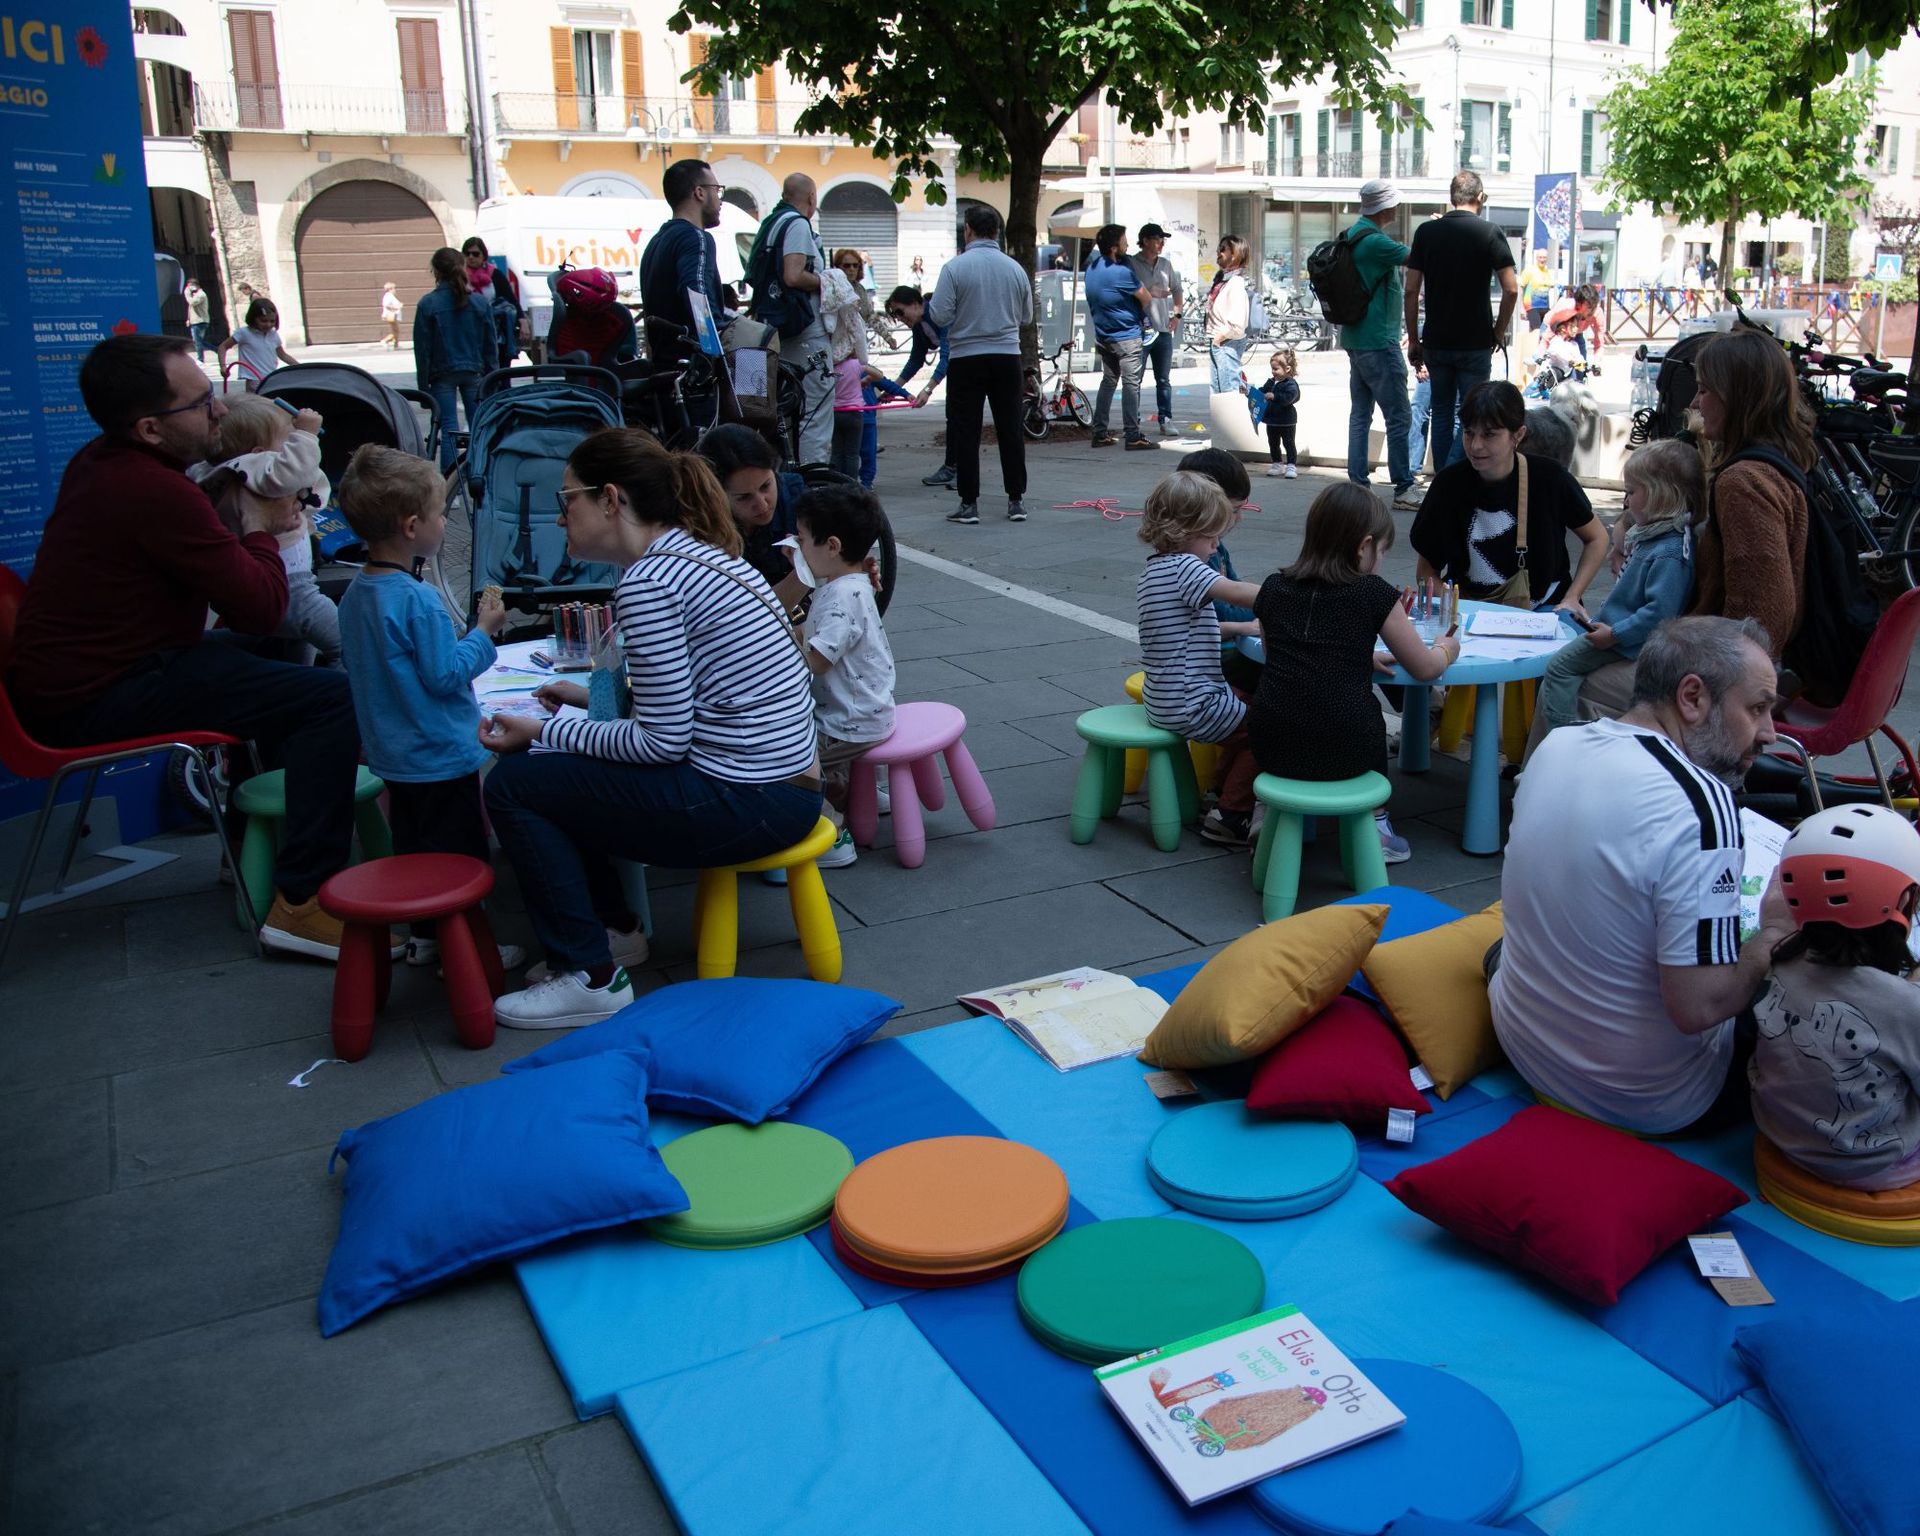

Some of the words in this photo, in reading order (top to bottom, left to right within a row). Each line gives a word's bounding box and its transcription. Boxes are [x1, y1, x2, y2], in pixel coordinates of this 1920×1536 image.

[14, 160, 33, 171] BIKE
[35, 162, 58, 173] TOUR
[33, 323, 53, 332] BIKE
[55, 323, 78, 332] TOUR
[79, 322, 98, 331] CON
[34, 334, 63, 343] GUIDA
[65, 333, 106, 342] TURISTICA
[1237, 1350, 1251, 1362] in
[1256, 1346, 1289, 1374] vanno
[1277, 1329, 1315, 1367] Elvis
[1322, 1374, 1367, 1414] Otto
